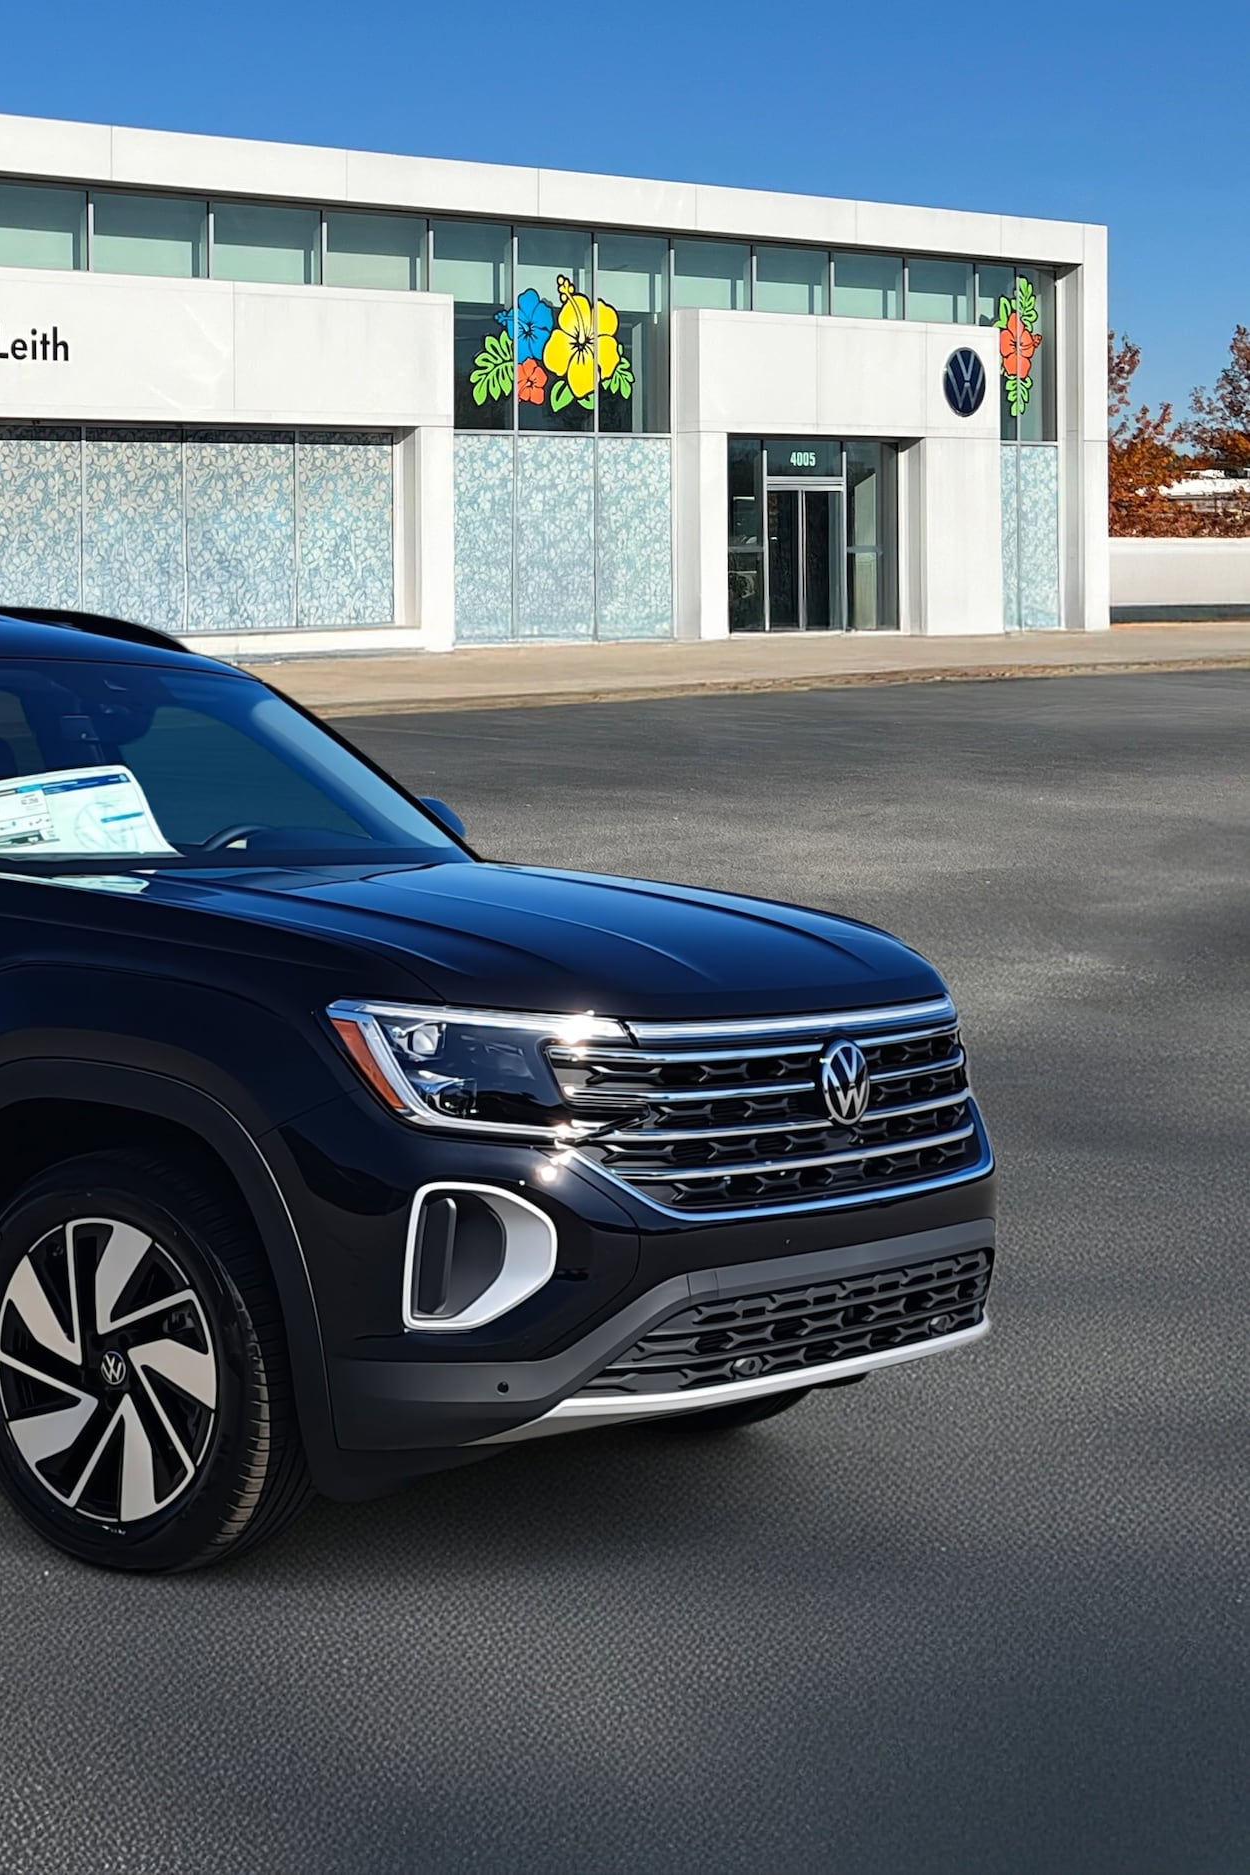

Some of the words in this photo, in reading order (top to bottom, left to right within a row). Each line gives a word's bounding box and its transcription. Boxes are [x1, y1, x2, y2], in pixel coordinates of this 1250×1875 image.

[946, 349, 984, 411] VW
[790, 451, 816, 467] 4005
[828, 1045, 867, 1119] VW
